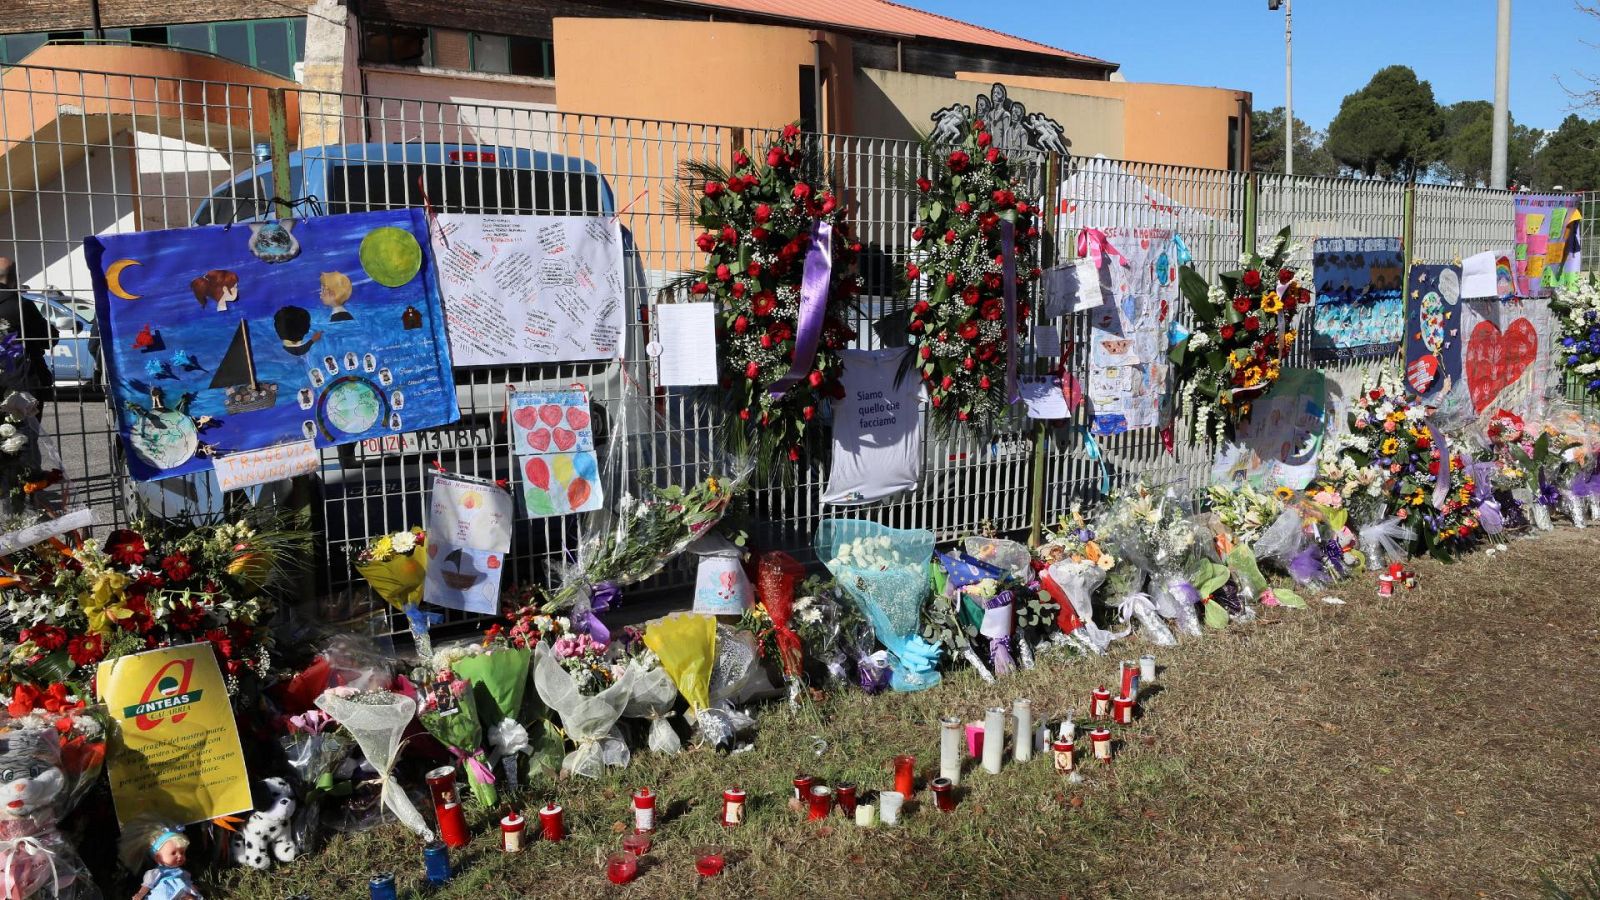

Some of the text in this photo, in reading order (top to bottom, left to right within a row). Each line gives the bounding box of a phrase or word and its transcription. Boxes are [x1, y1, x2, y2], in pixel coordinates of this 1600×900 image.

[857, 390, 883, 401] Siamo
[859, 401, 900, 416] quello che
[860, 416, 897, 428] facciamo
[363, 434, 408, 452] POLIZIA
[224, 444, 312, 471] TRAGEDIA
[181, 730, 204, 741] nostro
